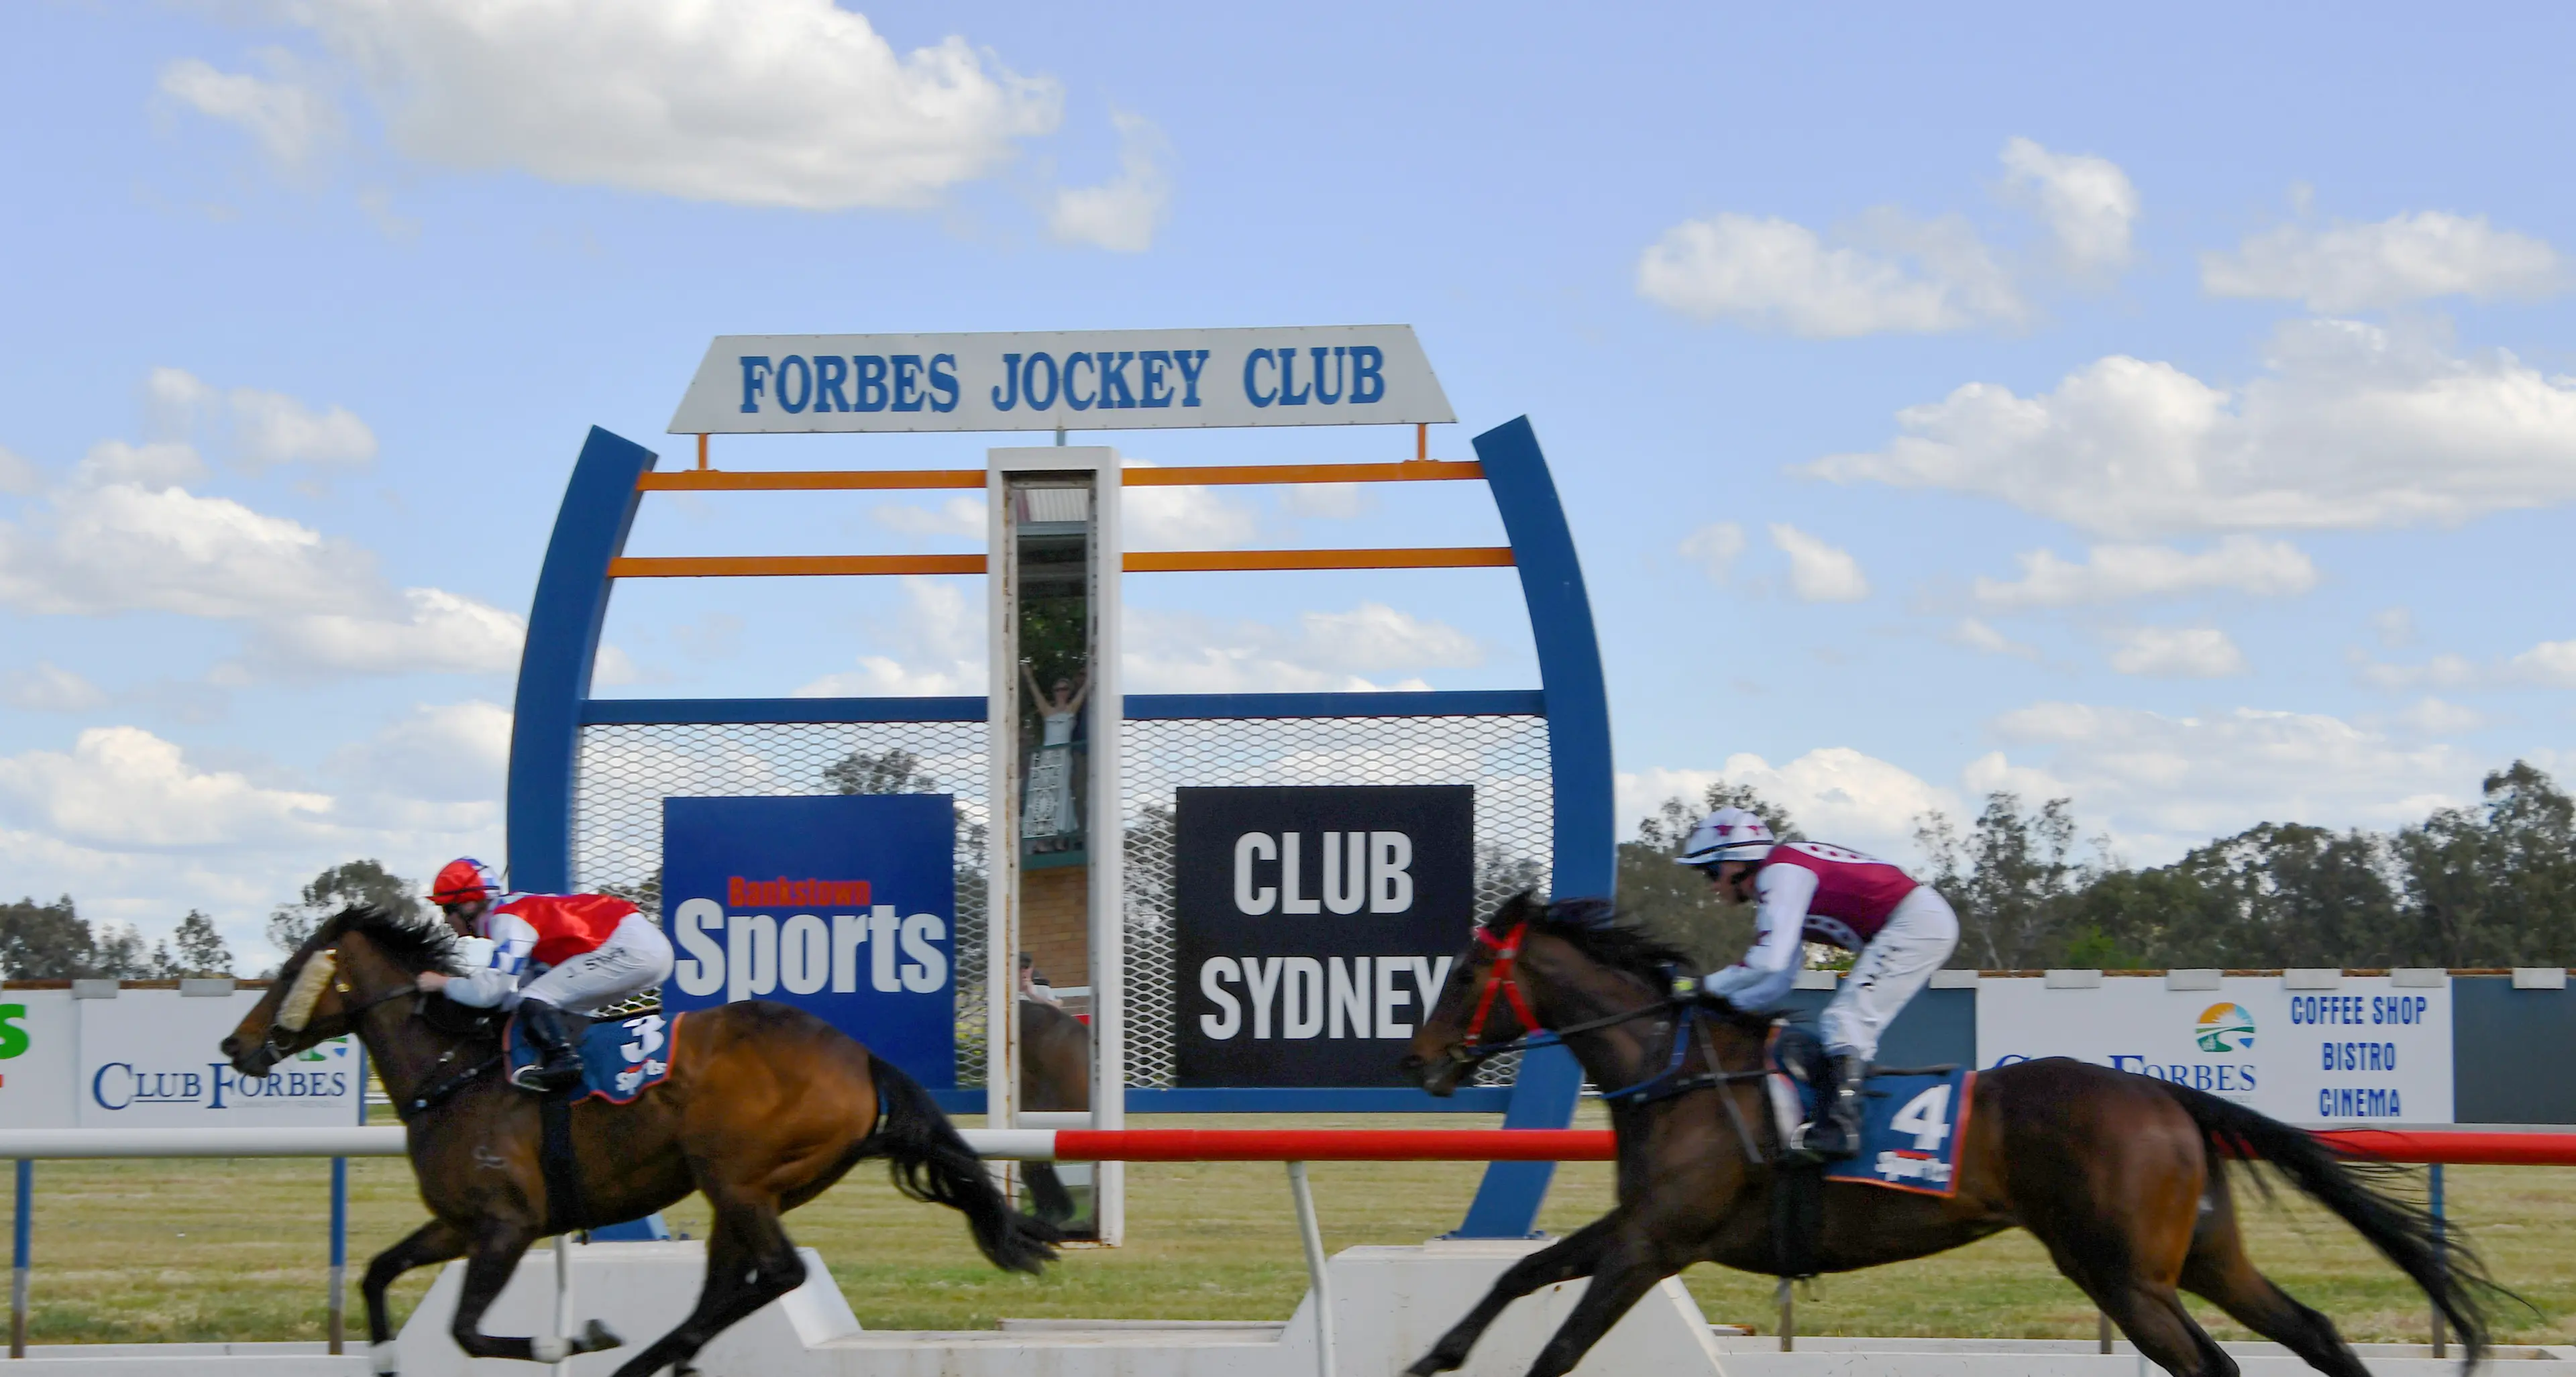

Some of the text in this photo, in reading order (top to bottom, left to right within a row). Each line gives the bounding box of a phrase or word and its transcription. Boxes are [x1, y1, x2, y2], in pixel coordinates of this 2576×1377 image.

[739, 345, 1385, 415] FORBES JOCKEY CLUB
[729, 876, 871, 907] Bankstown
[1234, 830, 1413, 916] CLUB
[674, 897, 948, 1003] Sports
[1199, 956, 1454, 1040] SYDNEY
[2292, 996, 2426, 1024] COFFEE SHOP
[620, 1014, 667, 1063] 3
[2322, 1042, 2396, 1070] BISTRO
[1890, 1083, 1952, 1150] 4
[2320, 1088, 2402, 1116] CINEMA
